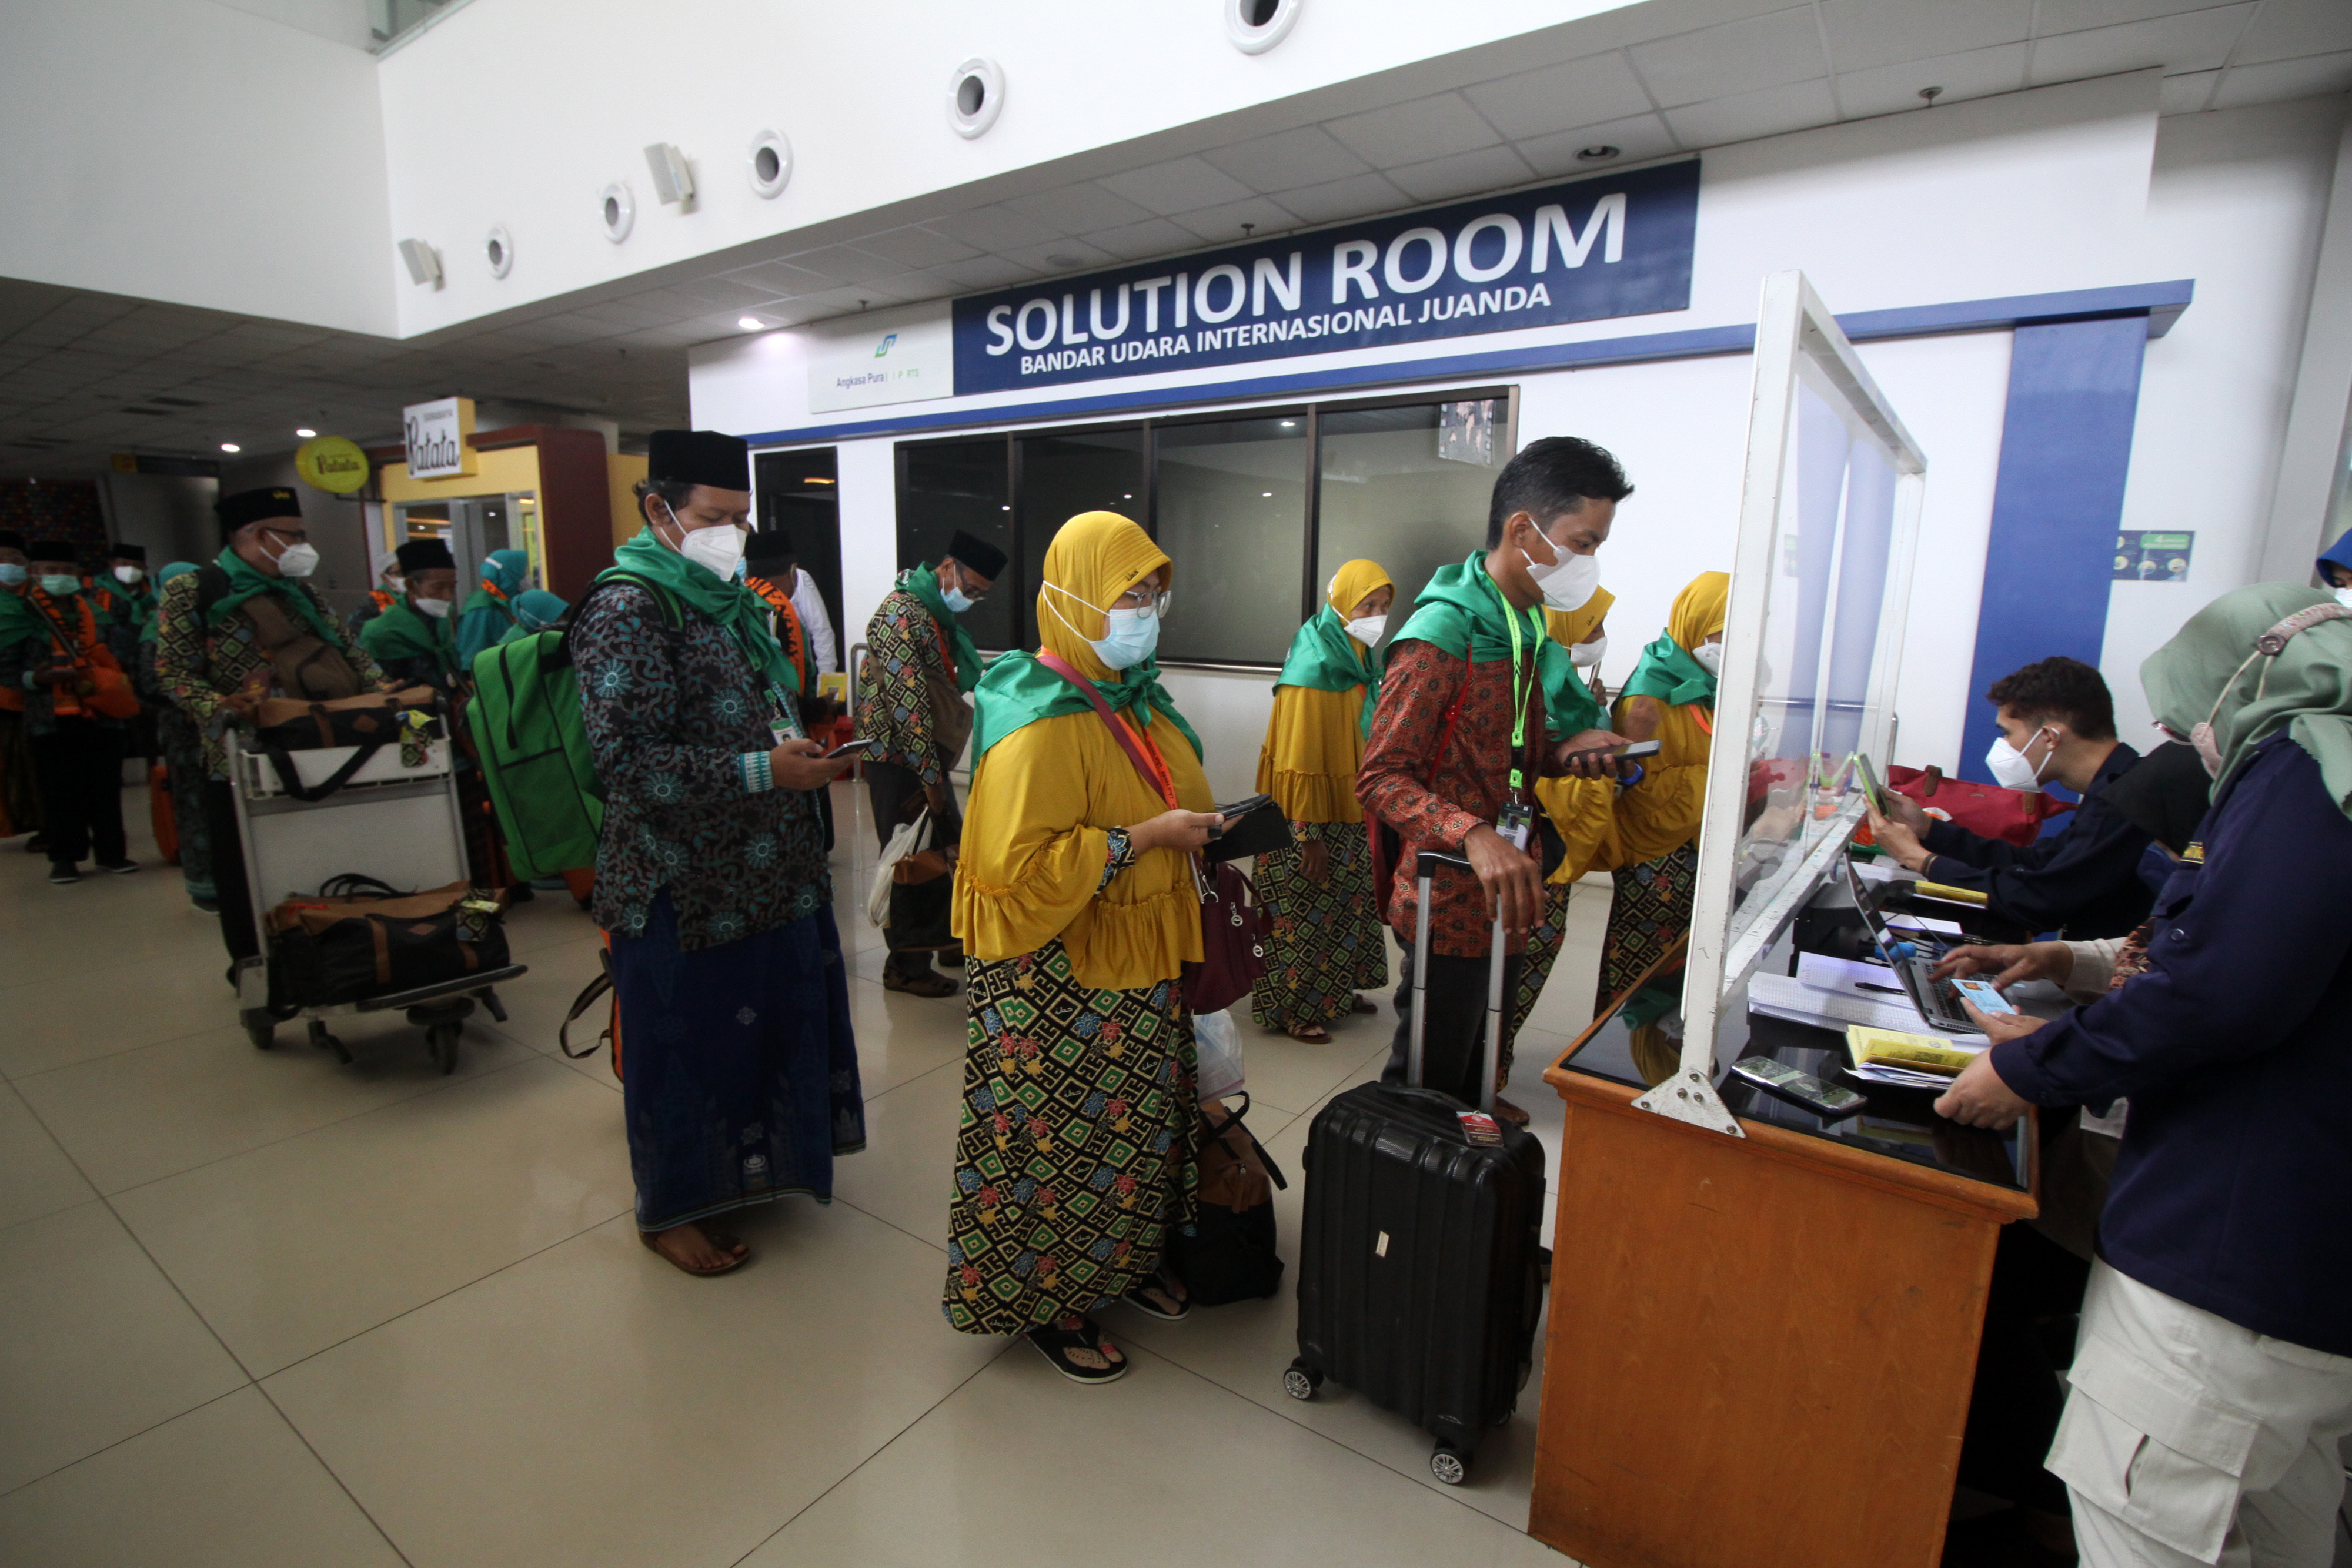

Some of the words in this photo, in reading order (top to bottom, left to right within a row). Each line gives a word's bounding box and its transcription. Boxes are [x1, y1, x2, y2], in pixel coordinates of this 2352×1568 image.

[986, 252, 1302, 356] SOLUTION
[1332, 192, 1627, 304] ROOM
[1021, 346, 1105, 375] BANDAR
[1111, 334, 1191, 363] UDARA
[1197, 303, 1412, 352] INTERNASIONAL
[1418, 282, 1551, 323] JUANDA
[837, 376, 866, 389] Angkasa
[867, 372, 884, 383] Pura
